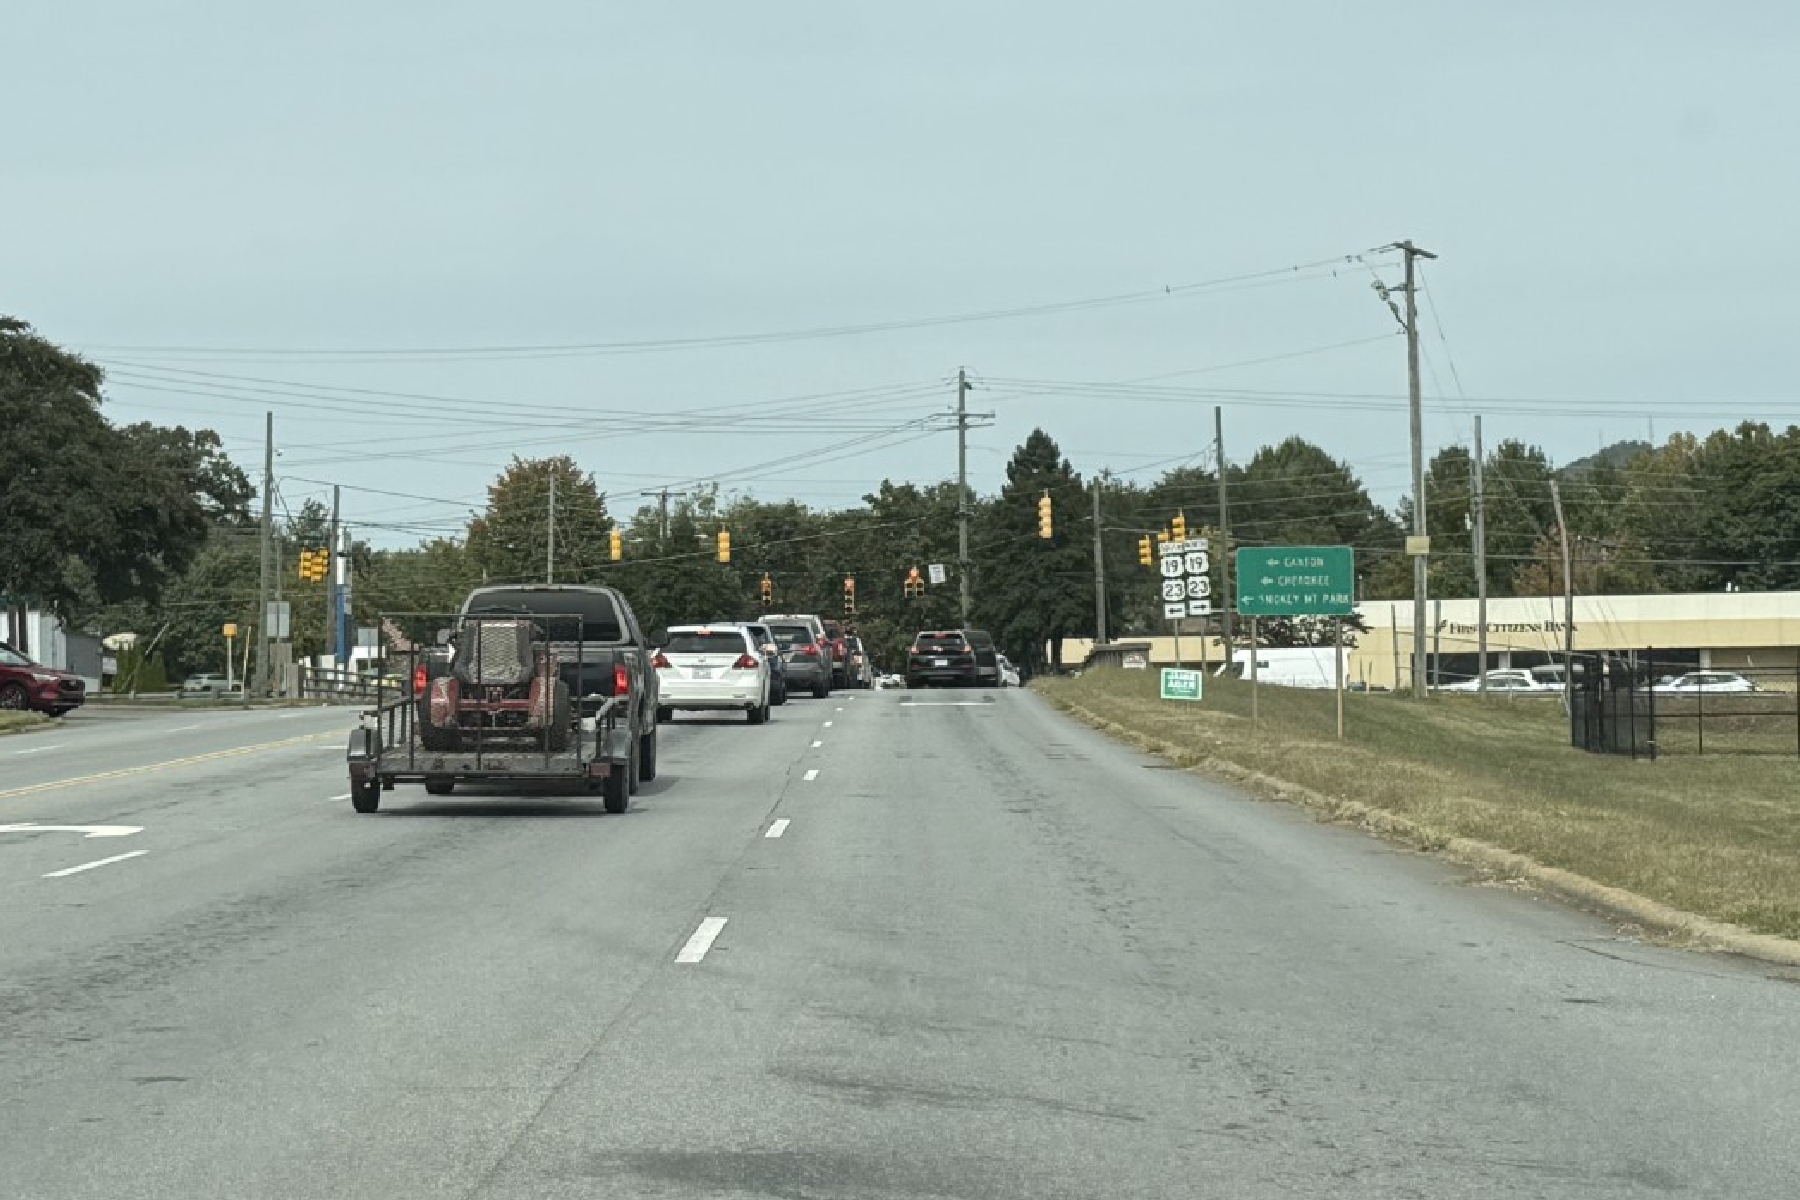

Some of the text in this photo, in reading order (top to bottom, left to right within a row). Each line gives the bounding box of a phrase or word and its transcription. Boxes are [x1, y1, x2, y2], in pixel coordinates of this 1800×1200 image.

[1165, 559, 1179, 573] 19
[1189, 556, 1203, 571] 19
[1165, 583, 1183, 597] 23
[1189, 580, 1207, 594] 23
[1450, 621, 1479, 635] FIRS
